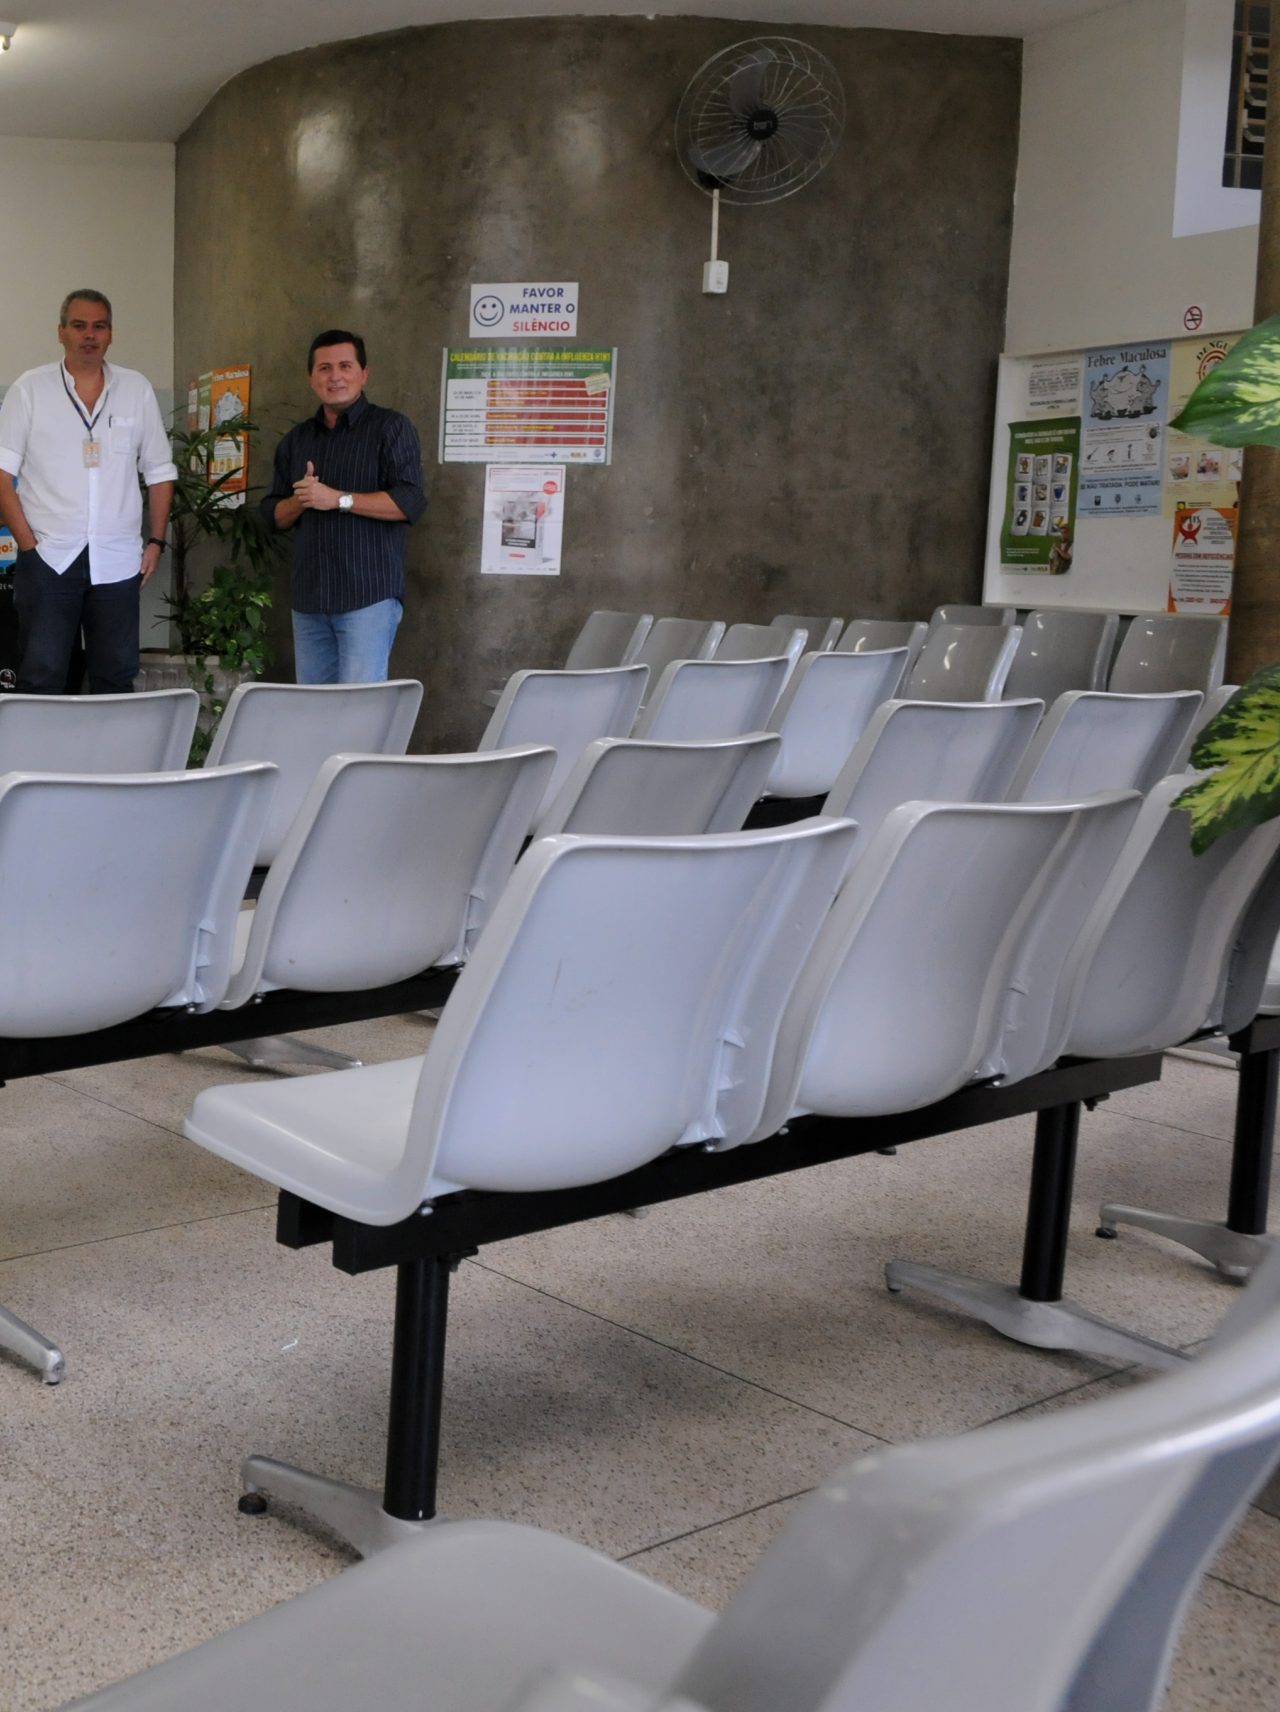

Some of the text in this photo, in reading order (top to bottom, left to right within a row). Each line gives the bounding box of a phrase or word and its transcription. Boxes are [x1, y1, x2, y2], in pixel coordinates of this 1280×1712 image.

[522, 287, 564, 298] FAVOR
[509, 302, 576, 314] MANTER O
[512, 318, 571, 332] SILÊNCIO
[1087, 348, 1167, 368] Febre Maculosa
